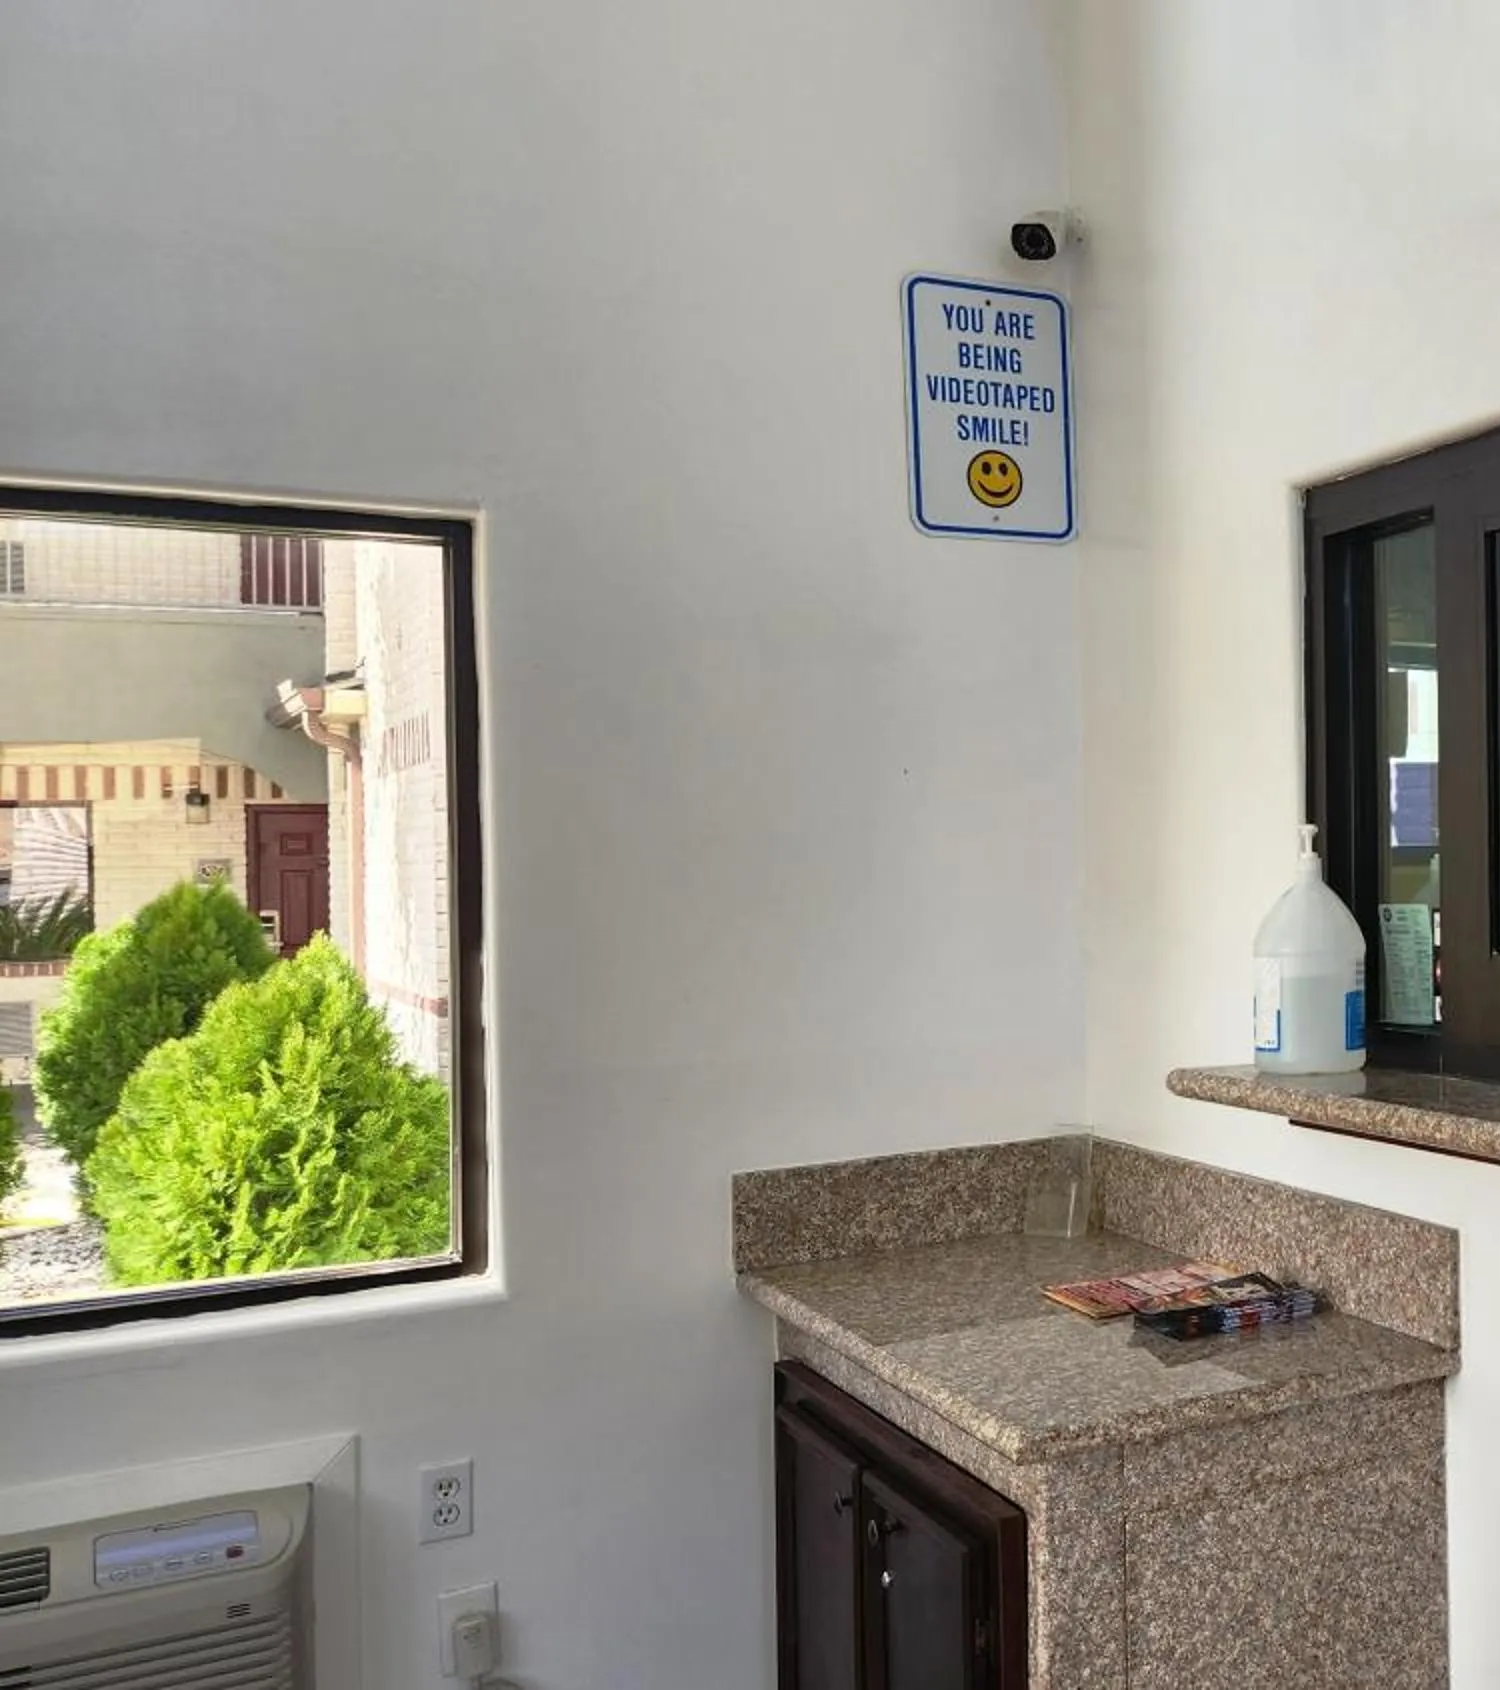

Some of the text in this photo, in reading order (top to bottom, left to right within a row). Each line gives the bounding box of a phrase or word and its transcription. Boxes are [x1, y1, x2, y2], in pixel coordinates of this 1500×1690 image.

[942, 303, 1036, 340] YOU ARE
[958, 342, 1022, 374] BEING
[926, 374, 1055, 413] VIDEOTAPED
[957, 414, 1029, 446] SMILE!
